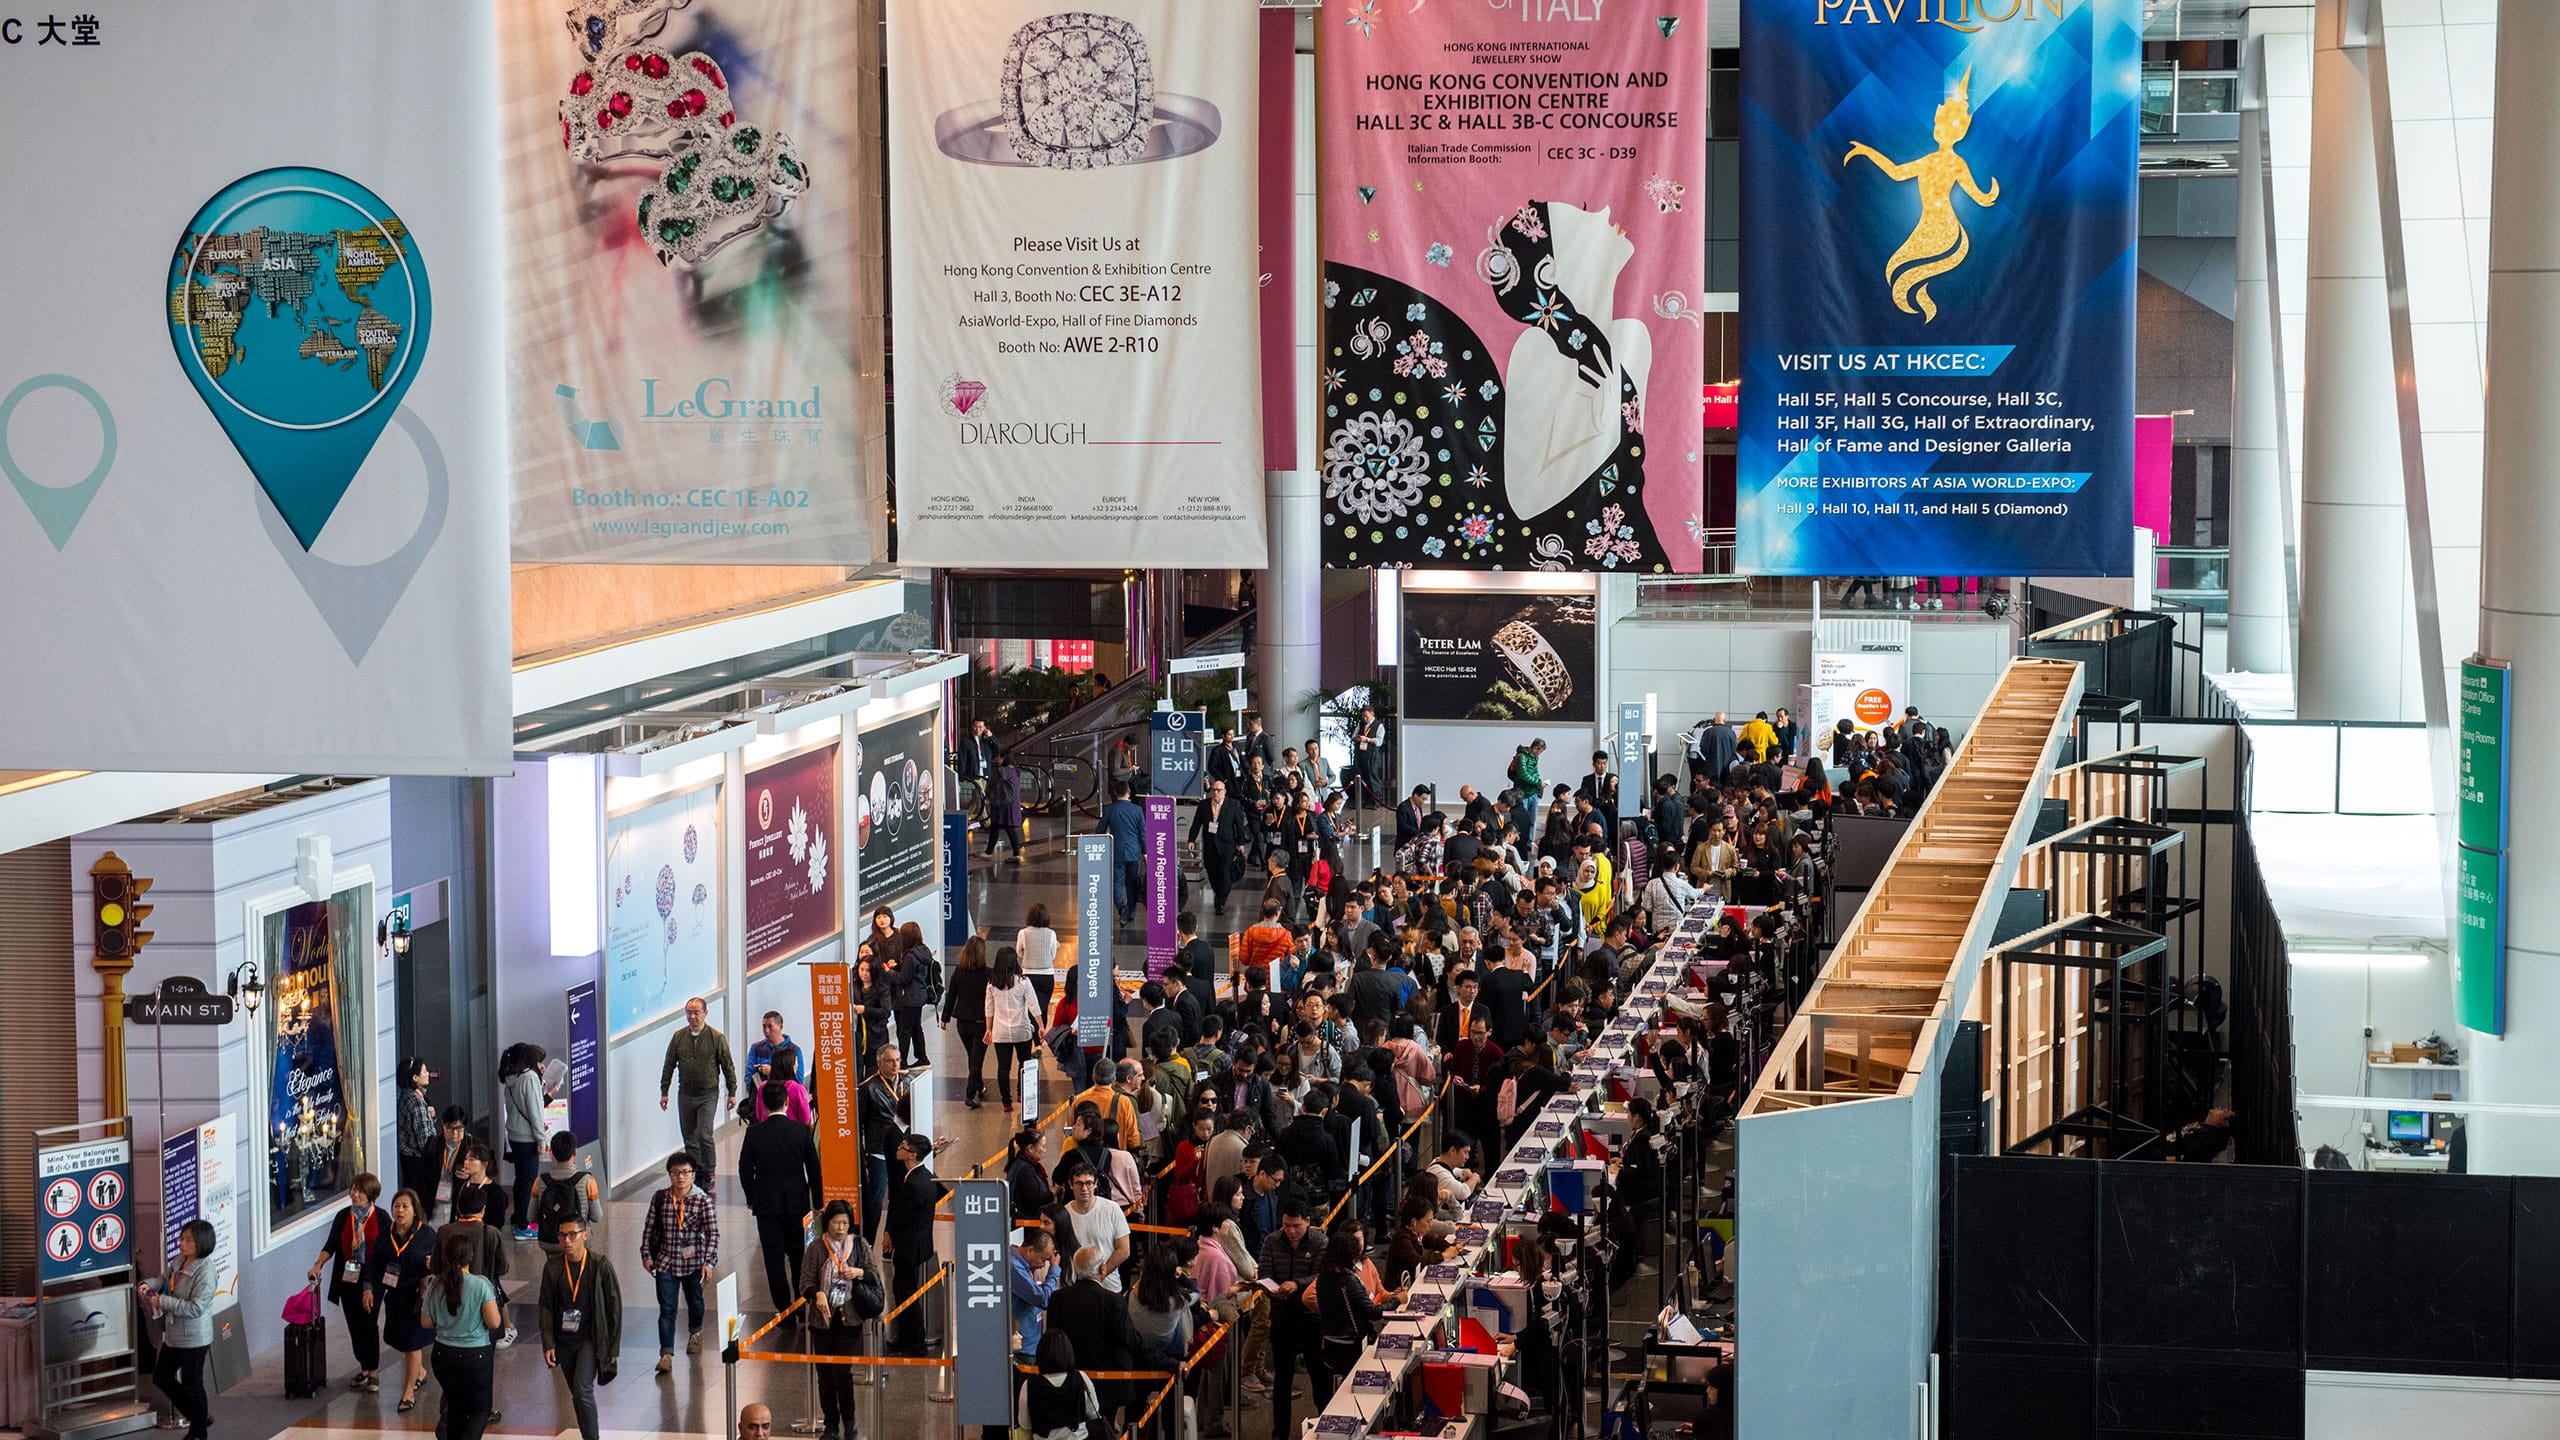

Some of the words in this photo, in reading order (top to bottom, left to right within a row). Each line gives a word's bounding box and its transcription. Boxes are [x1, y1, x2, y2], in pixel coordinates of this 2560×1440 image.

[1814, 0, 2064, 33] PAVILION
[37, 14, 100, 46] 大堂
[1444, 43, 1473, 51] HONG
[1477, 43, 1506, 51] KONG
[1510, 42, 1590, 51] INTERNATIONAL
[1472, 55, 1526, 64] JEWELLERY
[1530, 55, 1561, 63] SHOW
[1367, 75, 1422, 90] HONG
[1430, 74, 1485, 89] KONG
[1493, 73, 1618, 89] CONVENTION
[1626, 72, 1667, 87] AND
[1424, 94, 1531, 110] EXHIBITION
[1538, 93, 1608, 109] CENTRE
[1357, 115, 1404, 130] HALL
[1410, 115, 1432, 130] 3C
[1438, 115, 1451, 129] &
[1459, 114, 1506, 129] HALL
[1512, 114, 1553, 129] 3B-C
[1560, 112, 1677, 129] CONCOURSE
[1408, 144, 1438, 152] Italian
[1441, 144, 1468, 152] Trade
[1471, 144, 1531, 152] Commission
[1548, 148, 1573, 159] CEC
[1578, 148, 1595, 159] 3C
[1610, 147, 1636, 159] D39
[1408, 154, 1465, 163] Information
[1470, 154, 1501, 163] Booth:
[1014, 237, 1062, 251] Please
[1066, 237, 1098, 251] Visit
[1103, 237, 1121, 251] Us
[1126, 238, 1140, 251] at
[209, 251, 246, 260] EUROPE
[347, 250, 376, 259] NORTH
[262, 258, 296, 271] ASIA
[348, 258, 384, 266] AMERICA
[944, 265, 977, 279] Hong
[981, 265, 1013, 279] Kong
[1017, 264, 1088, 275] Convention
[1092, 264, 1101, 275] &
[1105, 263, 1166, 275] Exhibition
[1171, 263, 1211, 274] Centre
[216, 282, 247, 290] MIDDLE
[216, 289, 237, 297] EAST
[974, 290, 998, 303] Hall
[1001, 290, 1012, 304] 3,
[1015, 290, 1052, 303] Booth
[1056, 290, 1077, 303] No:
[1080, 286, 1114, 302] CEC
[1120, 285, 1182, 302] 3E-A12
[959, 315, 1058, 329] AsiaWorld-Expo,
[1063, 315, 1085, 326] Hall
[1089, 314, 1102, 326] of
[1106, 315, 1130, 326] Fine
[1134, 314, 1197, 326] Diamonds
[359, 329, 388, 337] SOUTH
[360, 336, 397, 344] AMERICA
[998, 341, 1036, 353] Booth
[1039, 342, 1060, 353] No:
[1064, 337, 1103, 353] AWE
[1108, 337, 1159, 352] 2-R10
[316, 349, 358, 357] AUSTRALASIA
[1778, 355, 1832, 370] VISIT
[1839, 354, 1866, 370] US
[1873, 354, 1900, 370] AT
[1908, 354, 1985, 369] HKCEC:
[640, 378, 823, 419] LeGrand
[1778, 393, 1808, 406] Hall
[1815, 393, 1838, 408] 5F,
[1845, 393, 1875, 406] Hall
[1882, 393, 1891, 406] 5
[1897, 393, 1991, 408] Concourse,
[1998, 392, 2029, 405] Hall
[2035, 392, 2062, 407] 3C,
[1778, 416, 1808, 429] Hall
[1815, 416, 1838, 431] 3F,
[1844, 416, 1875, 429] Hall
[1881, 416, 1908, 431] 3G,
[1915, 416, 1945, 429] Hall
[1952, 415, 1969, 429] of
[1975, 415, 2094, 431] Extraordinary,
[961, 423, 1085, 444] DIAROUGH
[1778, 439, 1808, 453] Hall
[1814, 438, 1832, 453] of
[1837, 439, 1882, 453] Fame
[1888, 438, 1919, 453] and
[1926, 438, 2001, 456] Designer
[2006, 438, 2071, 453] Galleria
[1778, 477, 1818, 487] MORE
[1823, 477, 1907, 488] EXHIBITORS
[1911, 477, 1929, 488] AT
[1933, 478, 1967, 488] ASIA
[1972, 478, 2075, 488] WORLD-EXPO:
[572, 488, 636, 508] Booth
[642, 489, 681, 508] no.:
[686, 489, 727, 508] CEC
[735, 489, 809, 508] 1E-A02
[930, 495, 951, 503] HONG
[951, 495, 970, 503] KONG
[1017, 495, 1036, 503] INDIA
[1101, 495, 1127, 504] EUROPE
[1187, 495, 1204, 503] NEW
[1203, 496, 1221, 504] YORK
[1778, 504, 1801, 513] Hall
[1807, 503, 1817, 514] 9,
[1823, 503, 1847, 513] Hall
[1852, 503, 1869, 515] 10,
[1875, 503, 1899, 514] Hall
[1904, 504, 1917, 515] 11,
[1922, 503, 1947, 514] and
[1952, 503, 1977, 514] Hall
[1982, 504, 1989, 514] 5
[1994, 503, 2068, 516] (Diamond)
[592, 518, 790, 538] www.legrandjew.com
[1420, 638, 1455, 649] PETER
[1458, 638, 1482, 649] LAM
[1863, 696, 1882, 704] FREE
[1624, 708, 1639, 719] 出口
[2475, 730, 2496, 745] Rooms
[1161, 737, 1194, 753] 出口
[1624, 731, 1639, 763] Exit
[1161, 757, 1195, 771] Exit
[1150, 804, 1171, 813] 新登記
[1153, 812, 1168, 820] 買家
[1084, 844, 1106, 853] 已登記
[1155, 832, 1166, 863] New
[1088, 853, 1103, 861] 買家
[1155, 866, 1166, 925] Registrations
[1087, 874, 1101, 955] Pre-registered
[1087, 958, 1101, 998] Buyers
[818, 985, 842, 995] 確認及
[145, 1004, 192, 1016] MAIN
[199, 1004, 225, 1016] ST.
[831, 1011, 844, 1055] Badge
[819, 1011, 832, 1071] Re-issue
[286, 1067, 333, 1099] Elegance
[834, 1058, 848, 1124] Validation
[838, 1128, 851, 1138] &
[47, 1155, 64, 1164] Mind
[67, 1152, 81, 1161] Your
[83, 1147, 119, 1159] Belongings
[46, 1154, 121, 1174] 請小心看管您的財物
[965, 1194, 1000, 1215] 出口
[967, 1243, 1003, 1308] Exit
